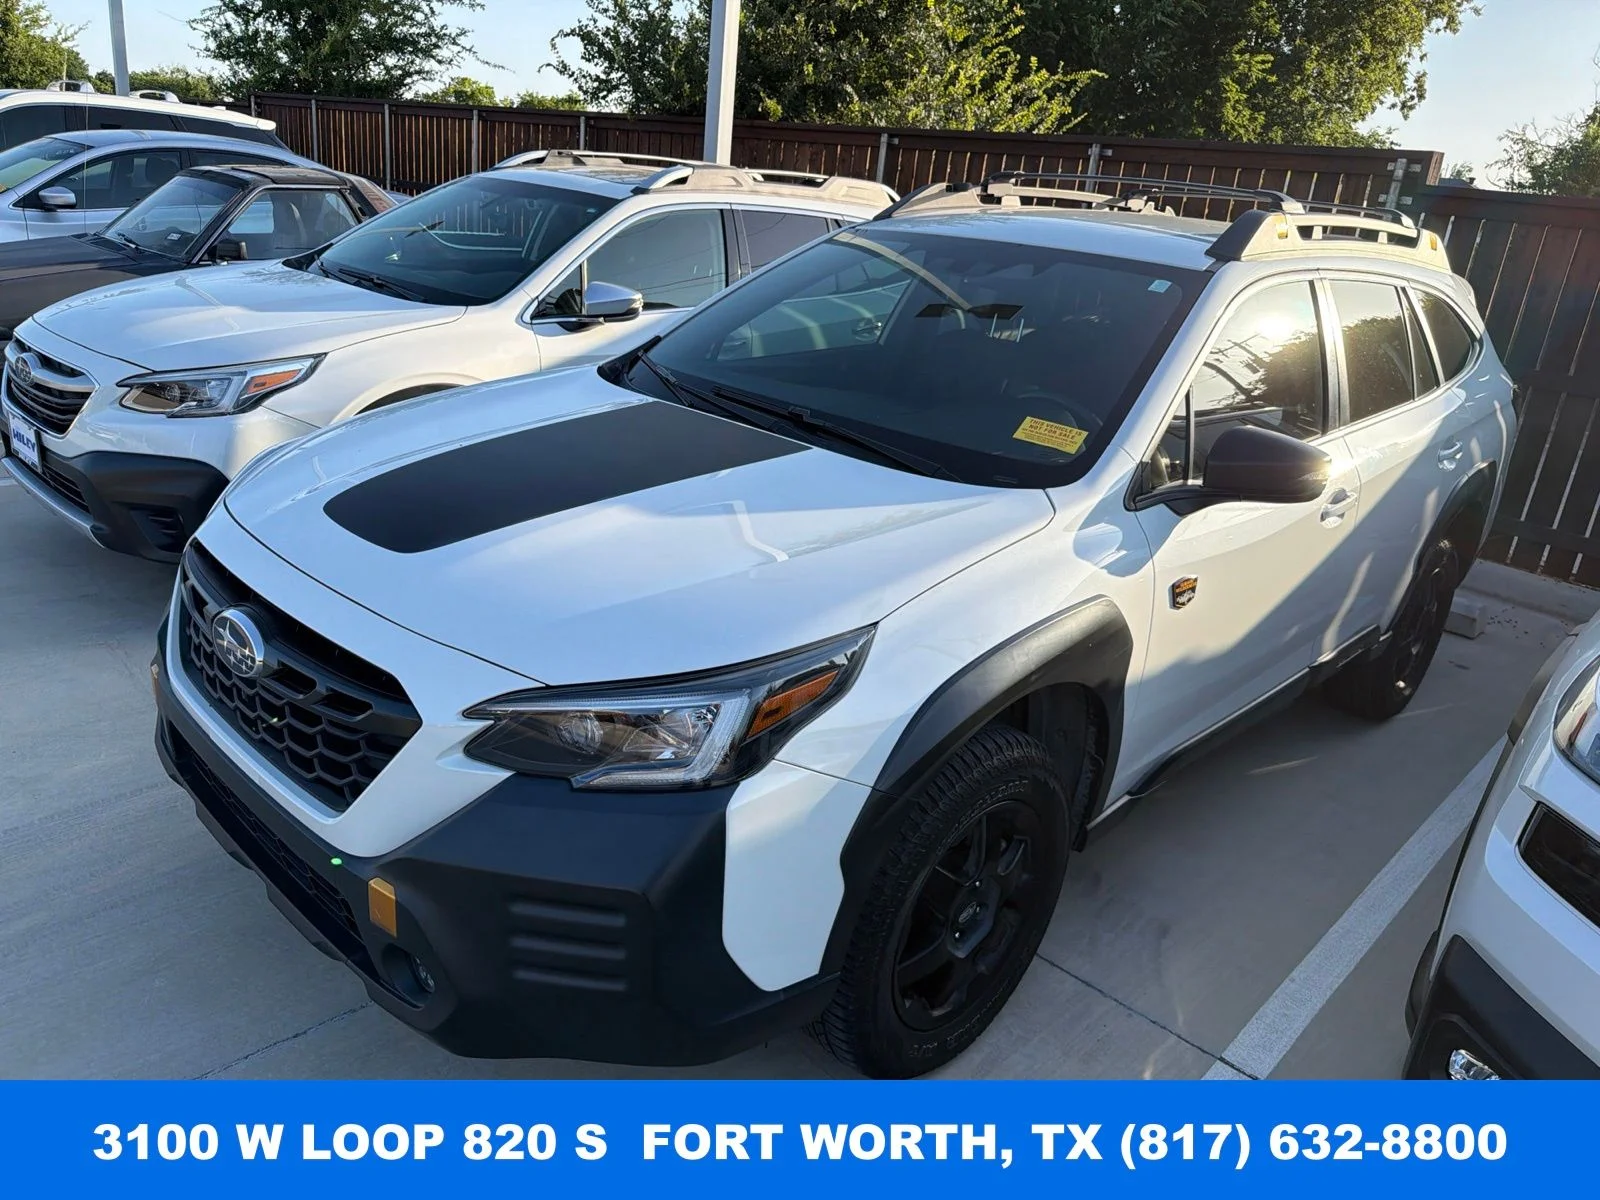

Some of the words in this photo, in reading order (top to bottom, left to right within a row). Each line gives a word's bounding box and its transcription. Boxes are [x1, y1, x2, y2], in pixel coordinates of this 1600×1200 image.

[1028, 424, 1042, 432] NOT
[1059, 431, 1076, 440] SALE
[1030, 419, 1046, 427] THIS
[1046, 423, 1074, 433] VEHICLE
[12, 428, 36, 453] HILEY
